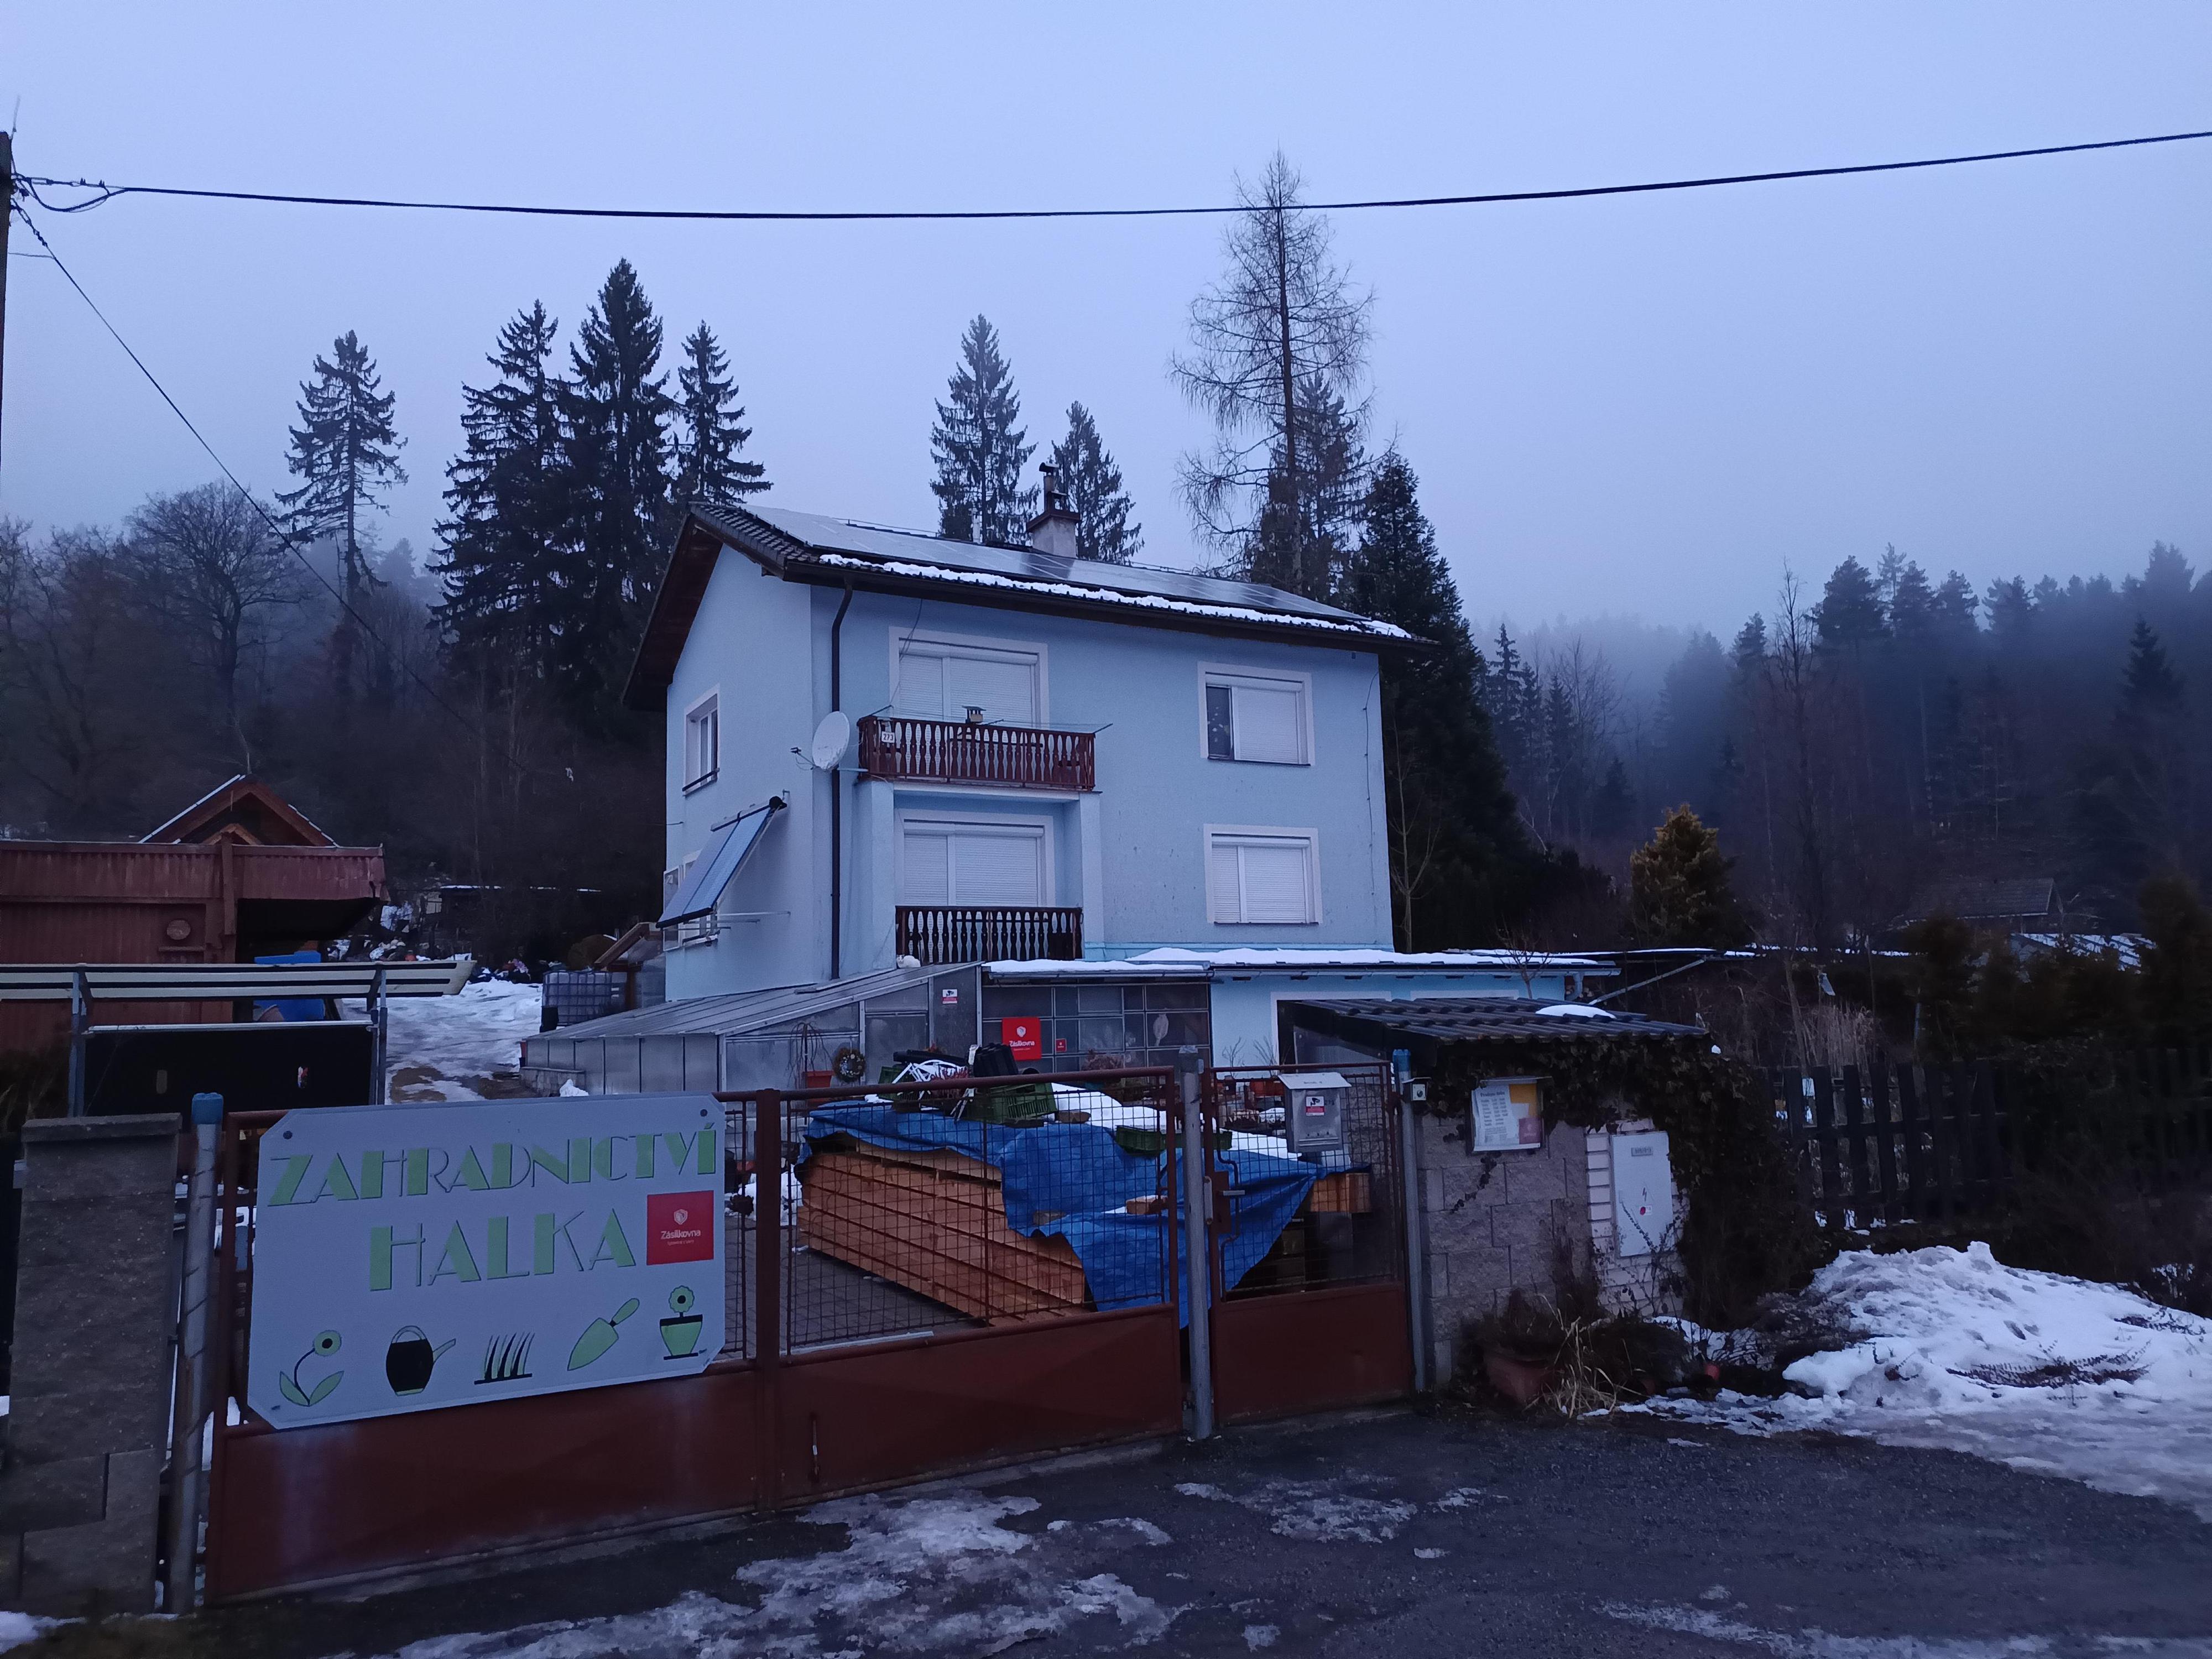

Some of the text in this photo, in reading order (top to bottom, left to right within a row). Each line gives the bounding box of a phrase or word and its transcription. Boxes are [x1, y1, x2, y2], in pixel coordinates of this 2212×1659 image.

[268, 1122, 716, 1207] ZAHRADNICTVÍ
[369, 1208, 636, 1291] HALKA
[661, 1230, 701, 1239] Zásilkovna
